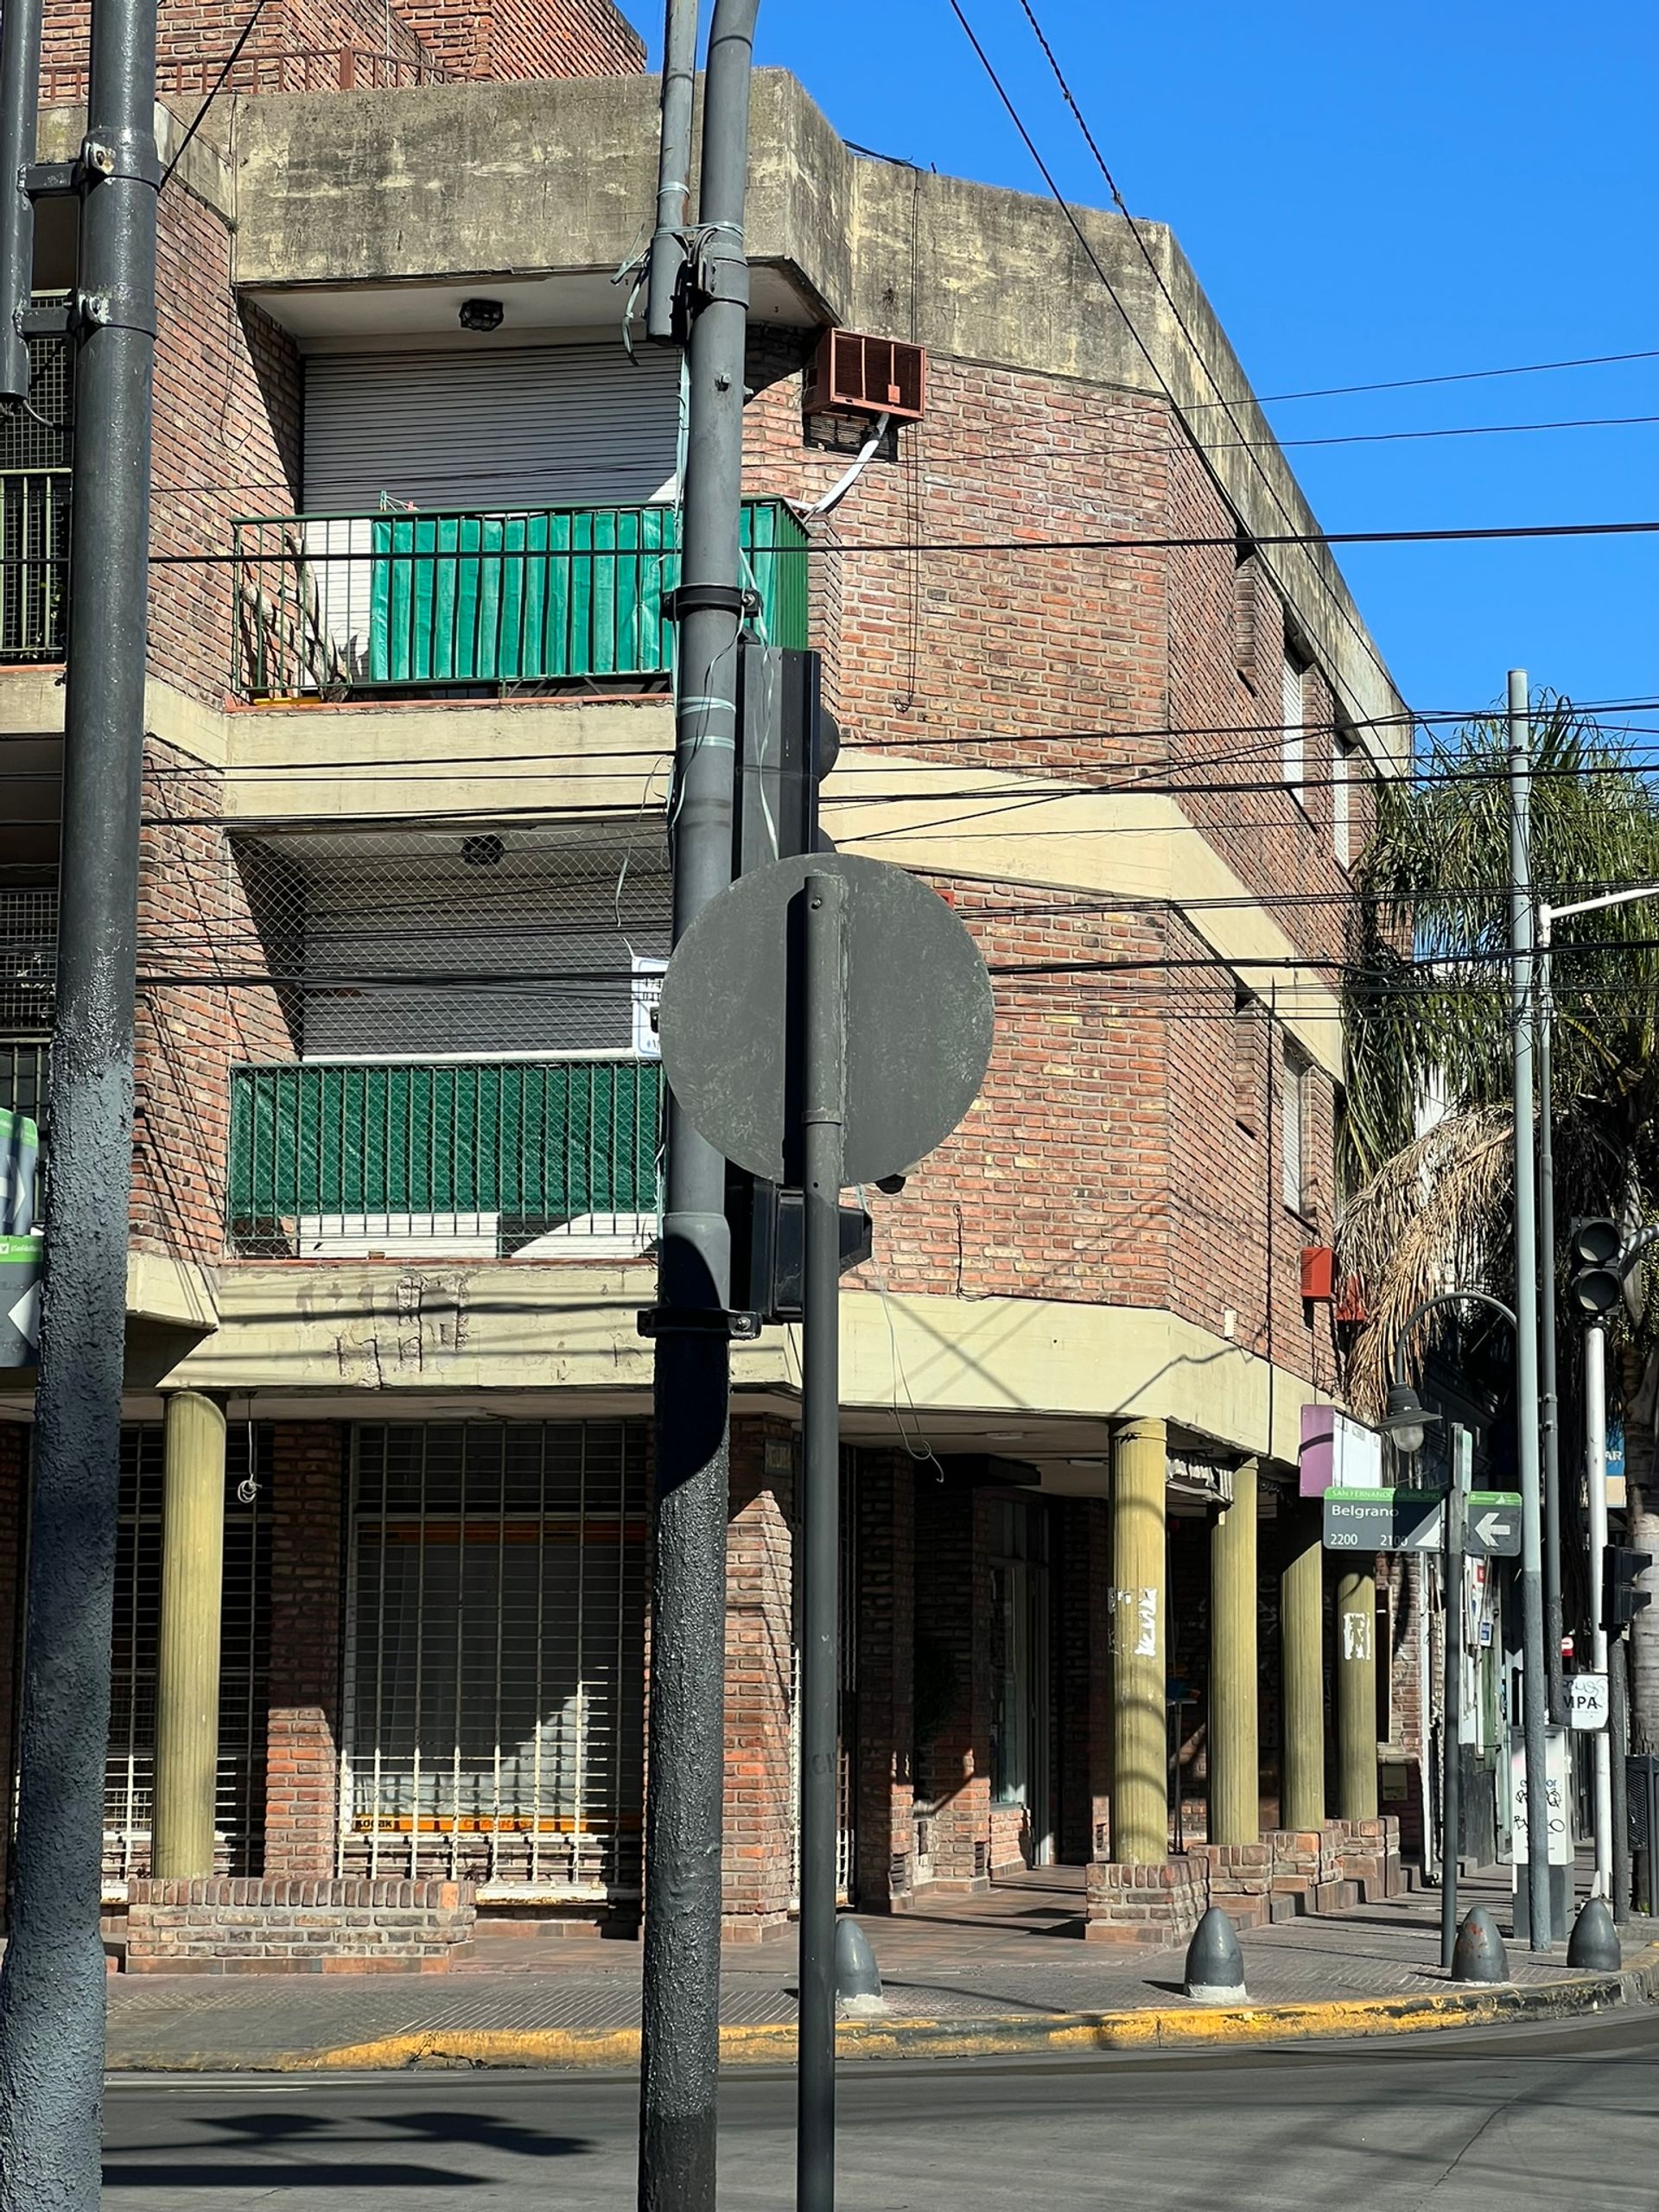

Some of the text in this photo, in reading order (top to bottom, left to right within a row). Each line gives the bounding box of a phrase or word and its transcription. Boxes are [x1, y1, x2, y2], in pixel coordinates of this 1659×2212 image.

[1332, 1504, 1399, 1518] Belgrano
[1331, 1534, 1408, 1547] 2200 2100
